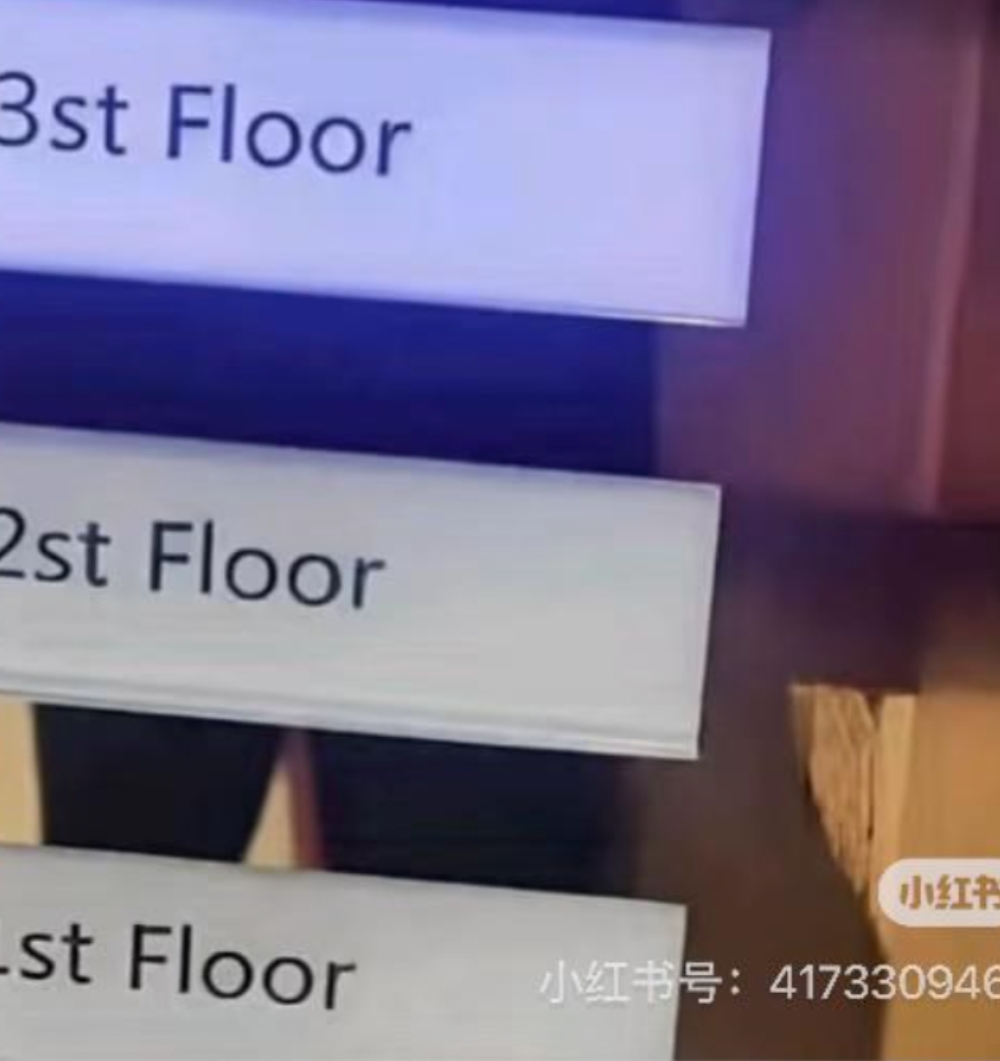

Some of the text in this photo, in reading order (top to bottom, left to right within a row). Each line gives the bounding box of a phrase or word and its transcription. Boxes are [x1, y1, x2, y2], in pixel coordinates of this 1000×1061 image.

[166, 83, 412, 177] Floor
[149, 519, 386, 610] Floor
[129, 923, 357, 1011] Floor
